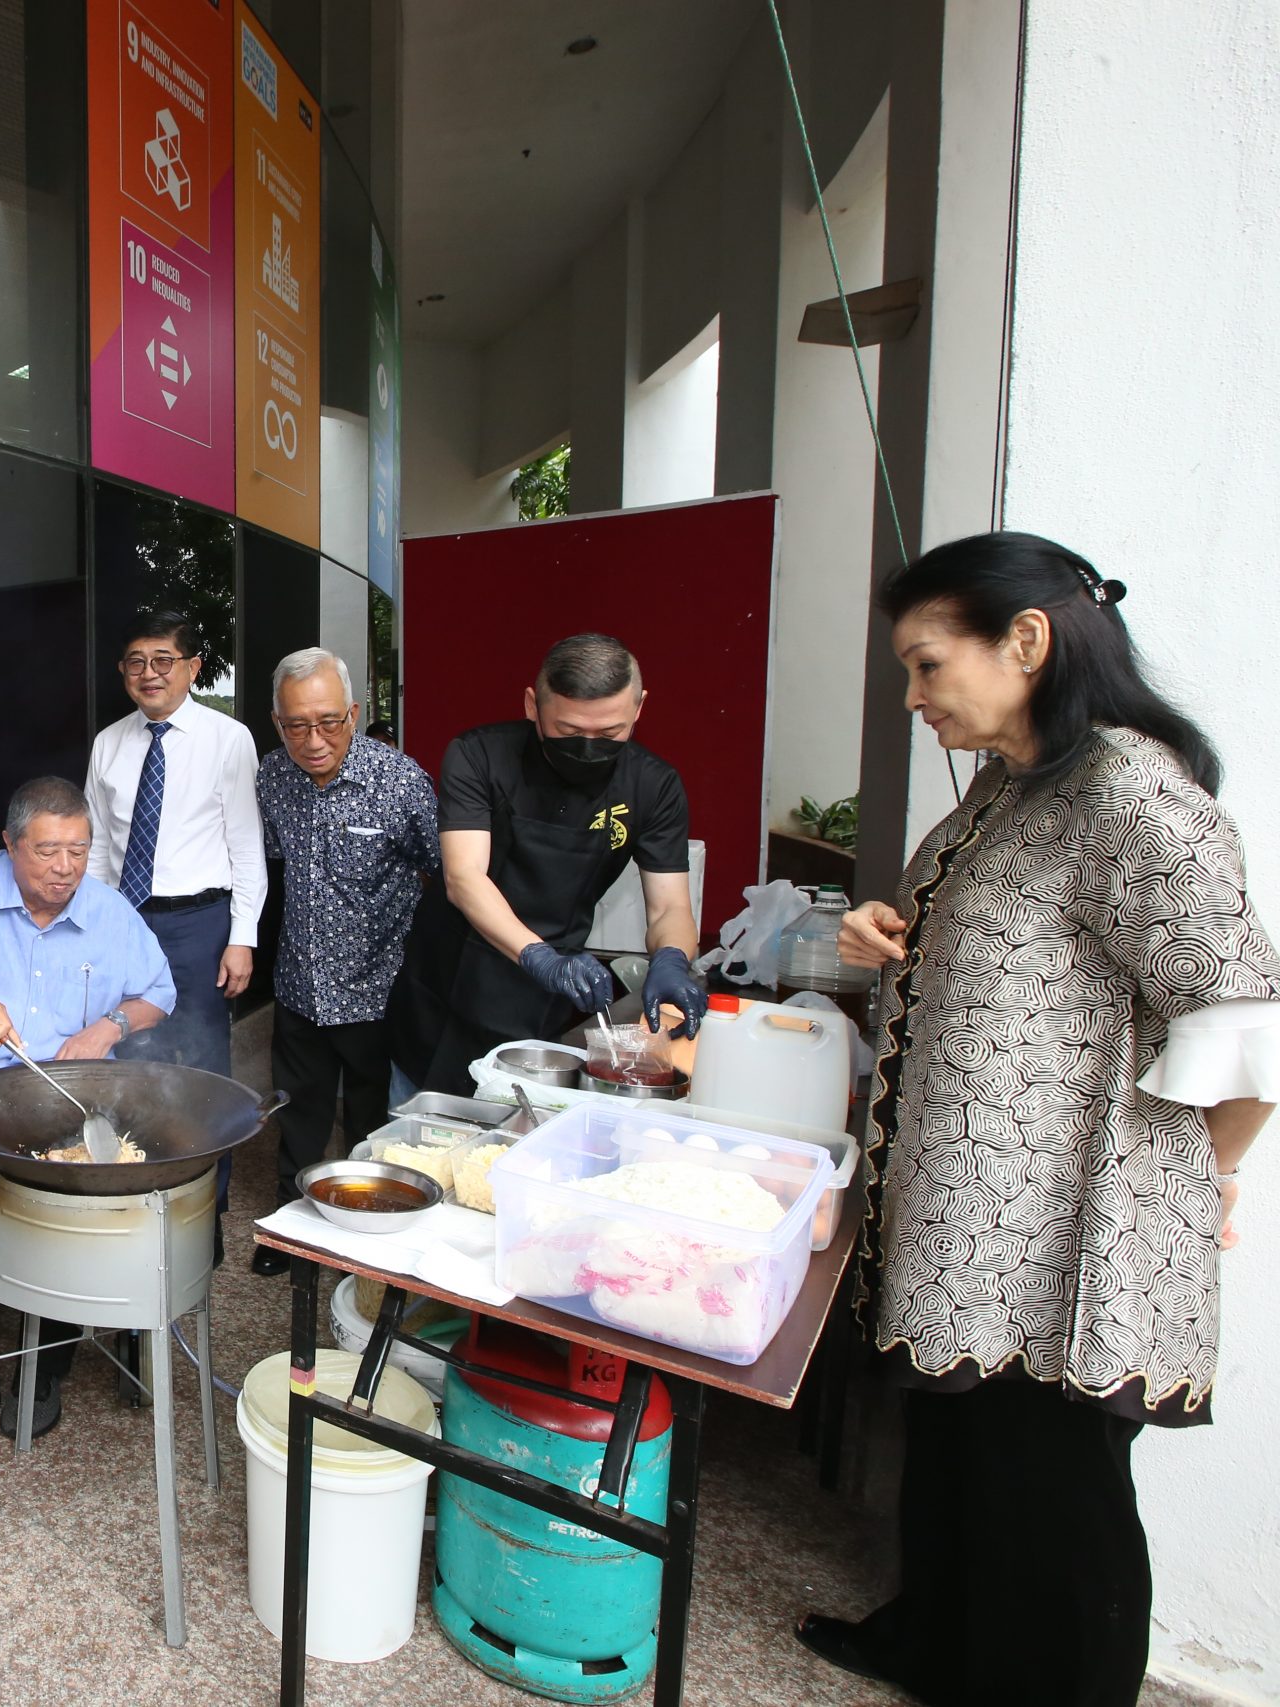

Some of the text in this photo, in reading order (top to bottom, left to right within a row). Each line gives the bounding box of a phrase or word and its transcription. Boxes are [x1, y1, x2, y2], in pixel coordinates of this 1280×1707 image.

[127, 20, 139, 63] 9
[141, 31, 205, 102] INDUSTRY, INNOVATION
[243, 56, 276, 114] GOALS
[141, 55, 205, 124] AND INFRASTRUCTURE
[256, 148, 266, 186] 11
[127, 240, 147, 285] 10
[152, 254, 180, 285] REDUCED
[152, 276, 192, 313] INEQUALITIES
[257, 329, 268, 365] 12
[582, 1364, 616, 1382] KG
